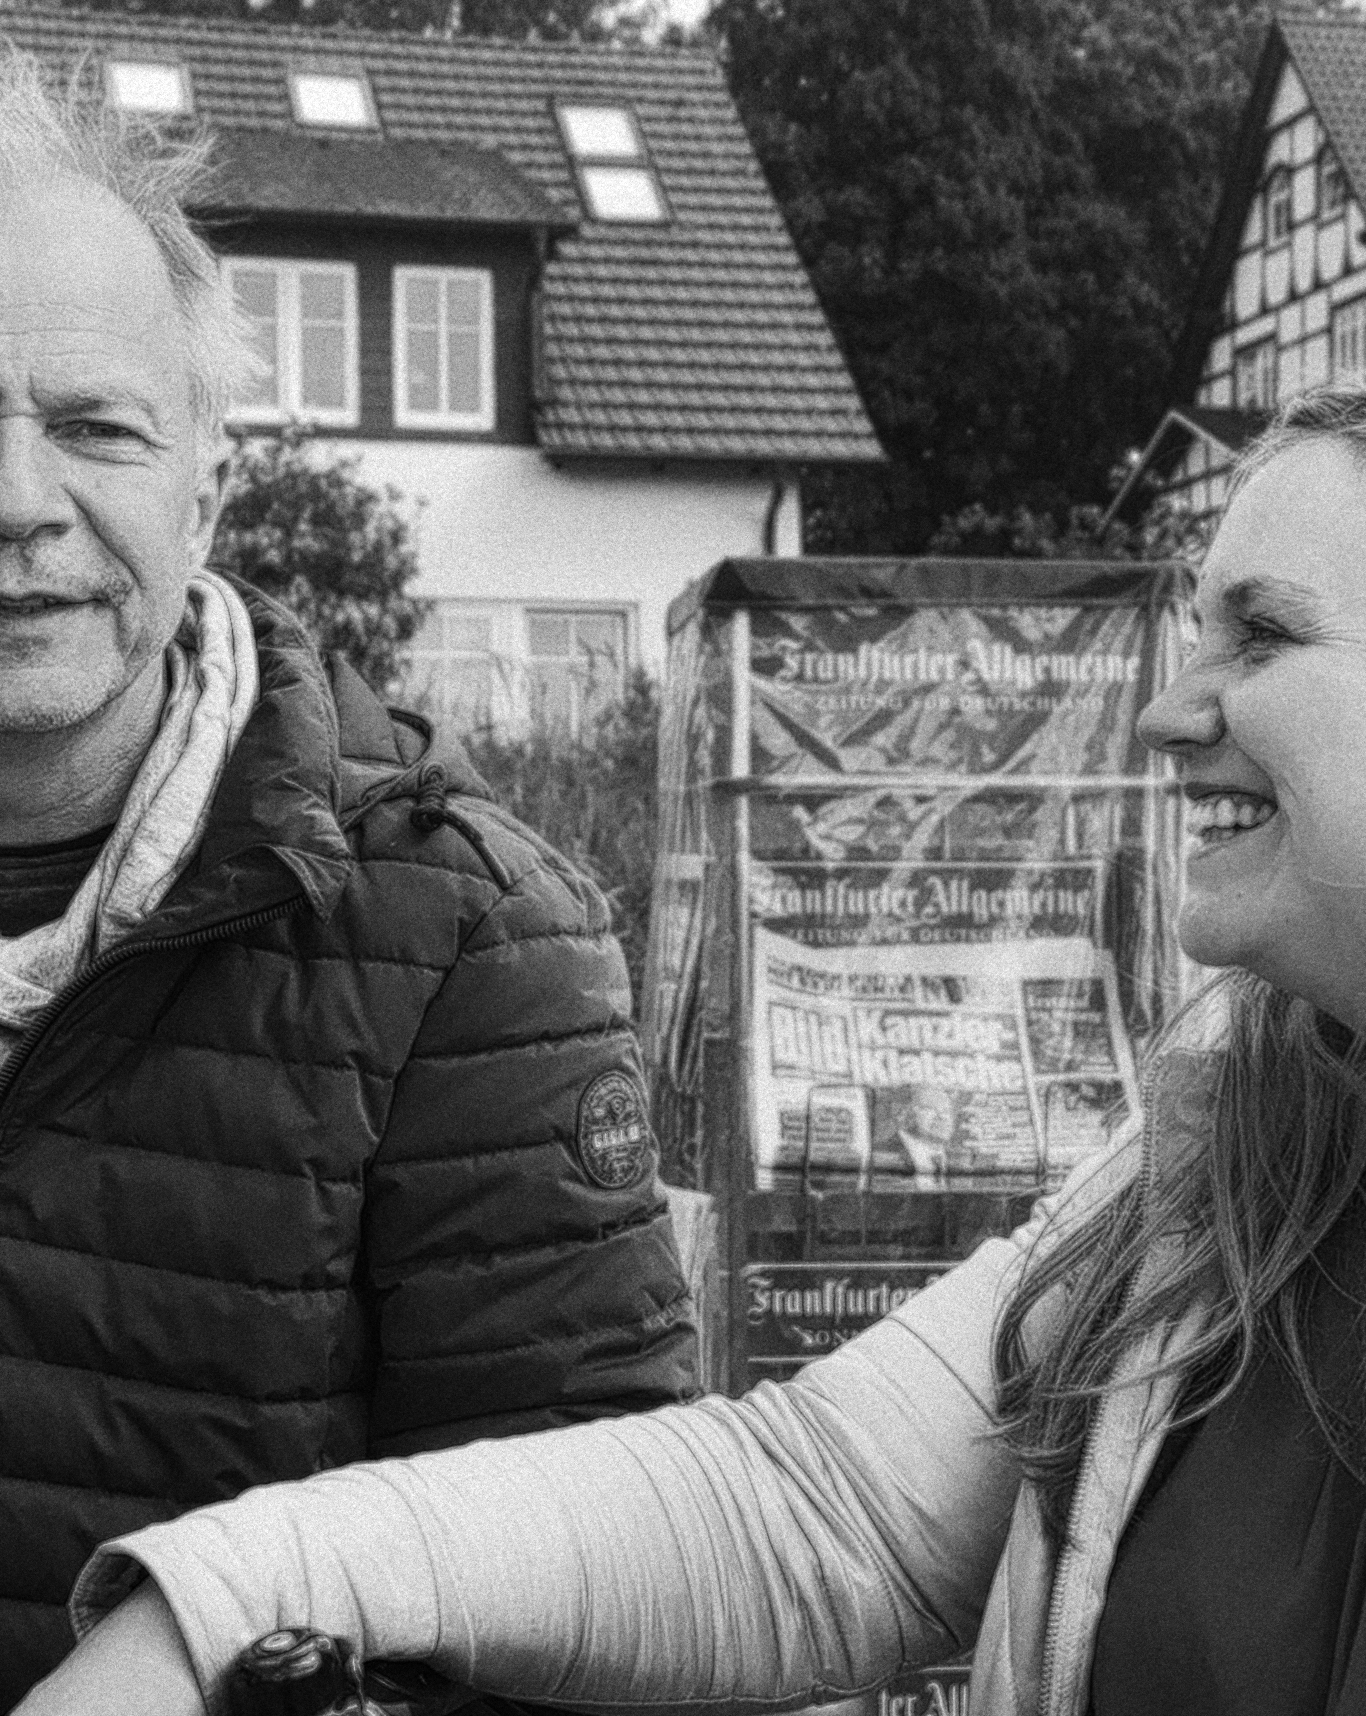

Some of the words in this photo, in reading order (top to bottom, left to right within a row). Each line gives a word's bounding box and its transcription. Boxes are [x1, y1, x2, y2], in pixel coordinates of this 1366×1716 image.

[774, 638, 960, 690] Frankfurter
[960, 637, 1141, 691] Allgemeine
[919, 876, 1090, 924] Allgemeine
[855, 1008, 1017, 1051] Kanzler-
[861, 1050, 1024, 1088] Klatsche
